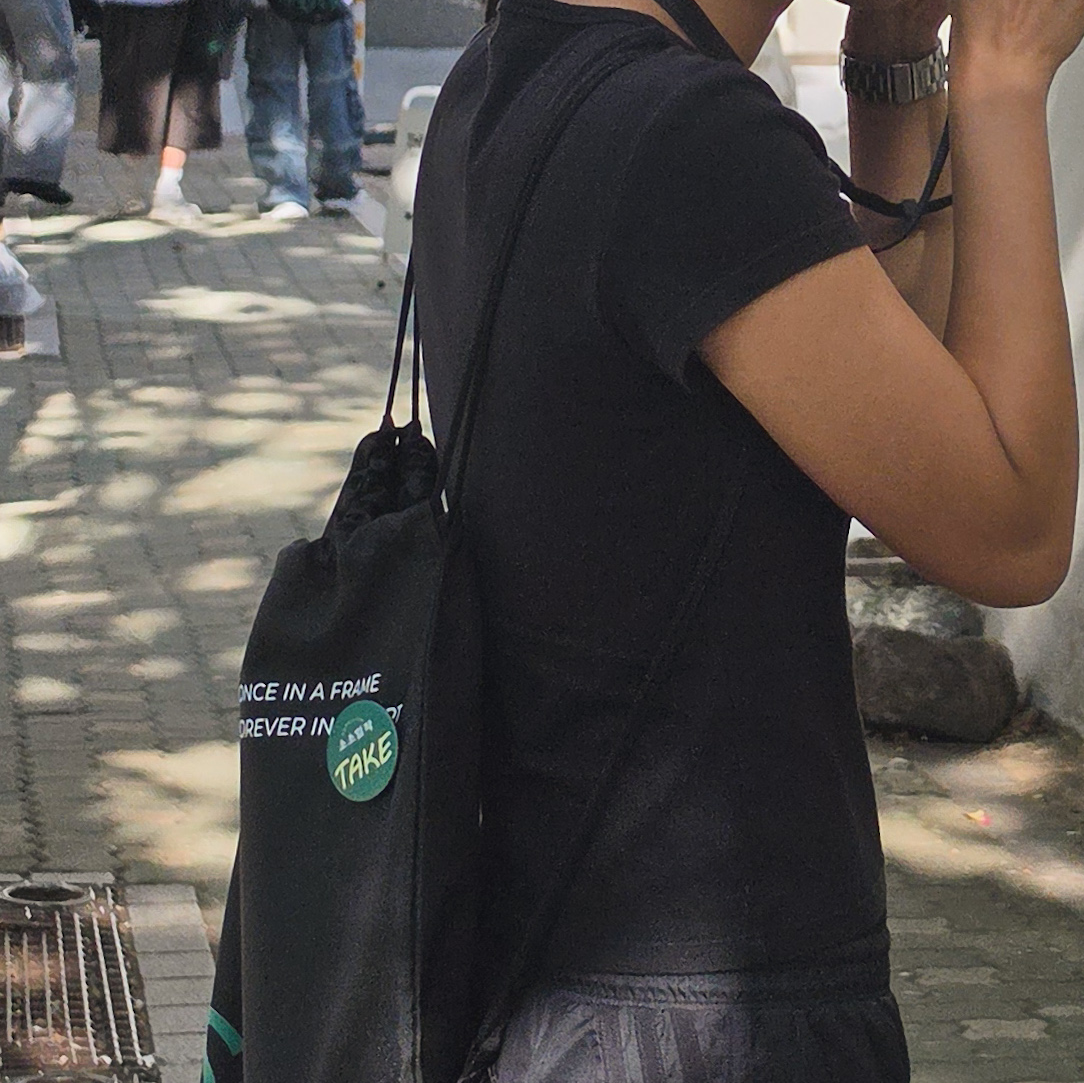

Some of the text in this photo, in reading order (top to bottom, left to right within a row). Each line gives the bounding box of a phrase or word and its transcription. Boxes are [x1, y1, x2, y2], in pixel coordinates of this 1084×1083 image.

[238, 673, 382, 704] ONCE IN A FRAME
[239, 716, 307, 739] OREVER
[310, 716, 335, 737] IN
[334, 730, 393, 790] TAKE
